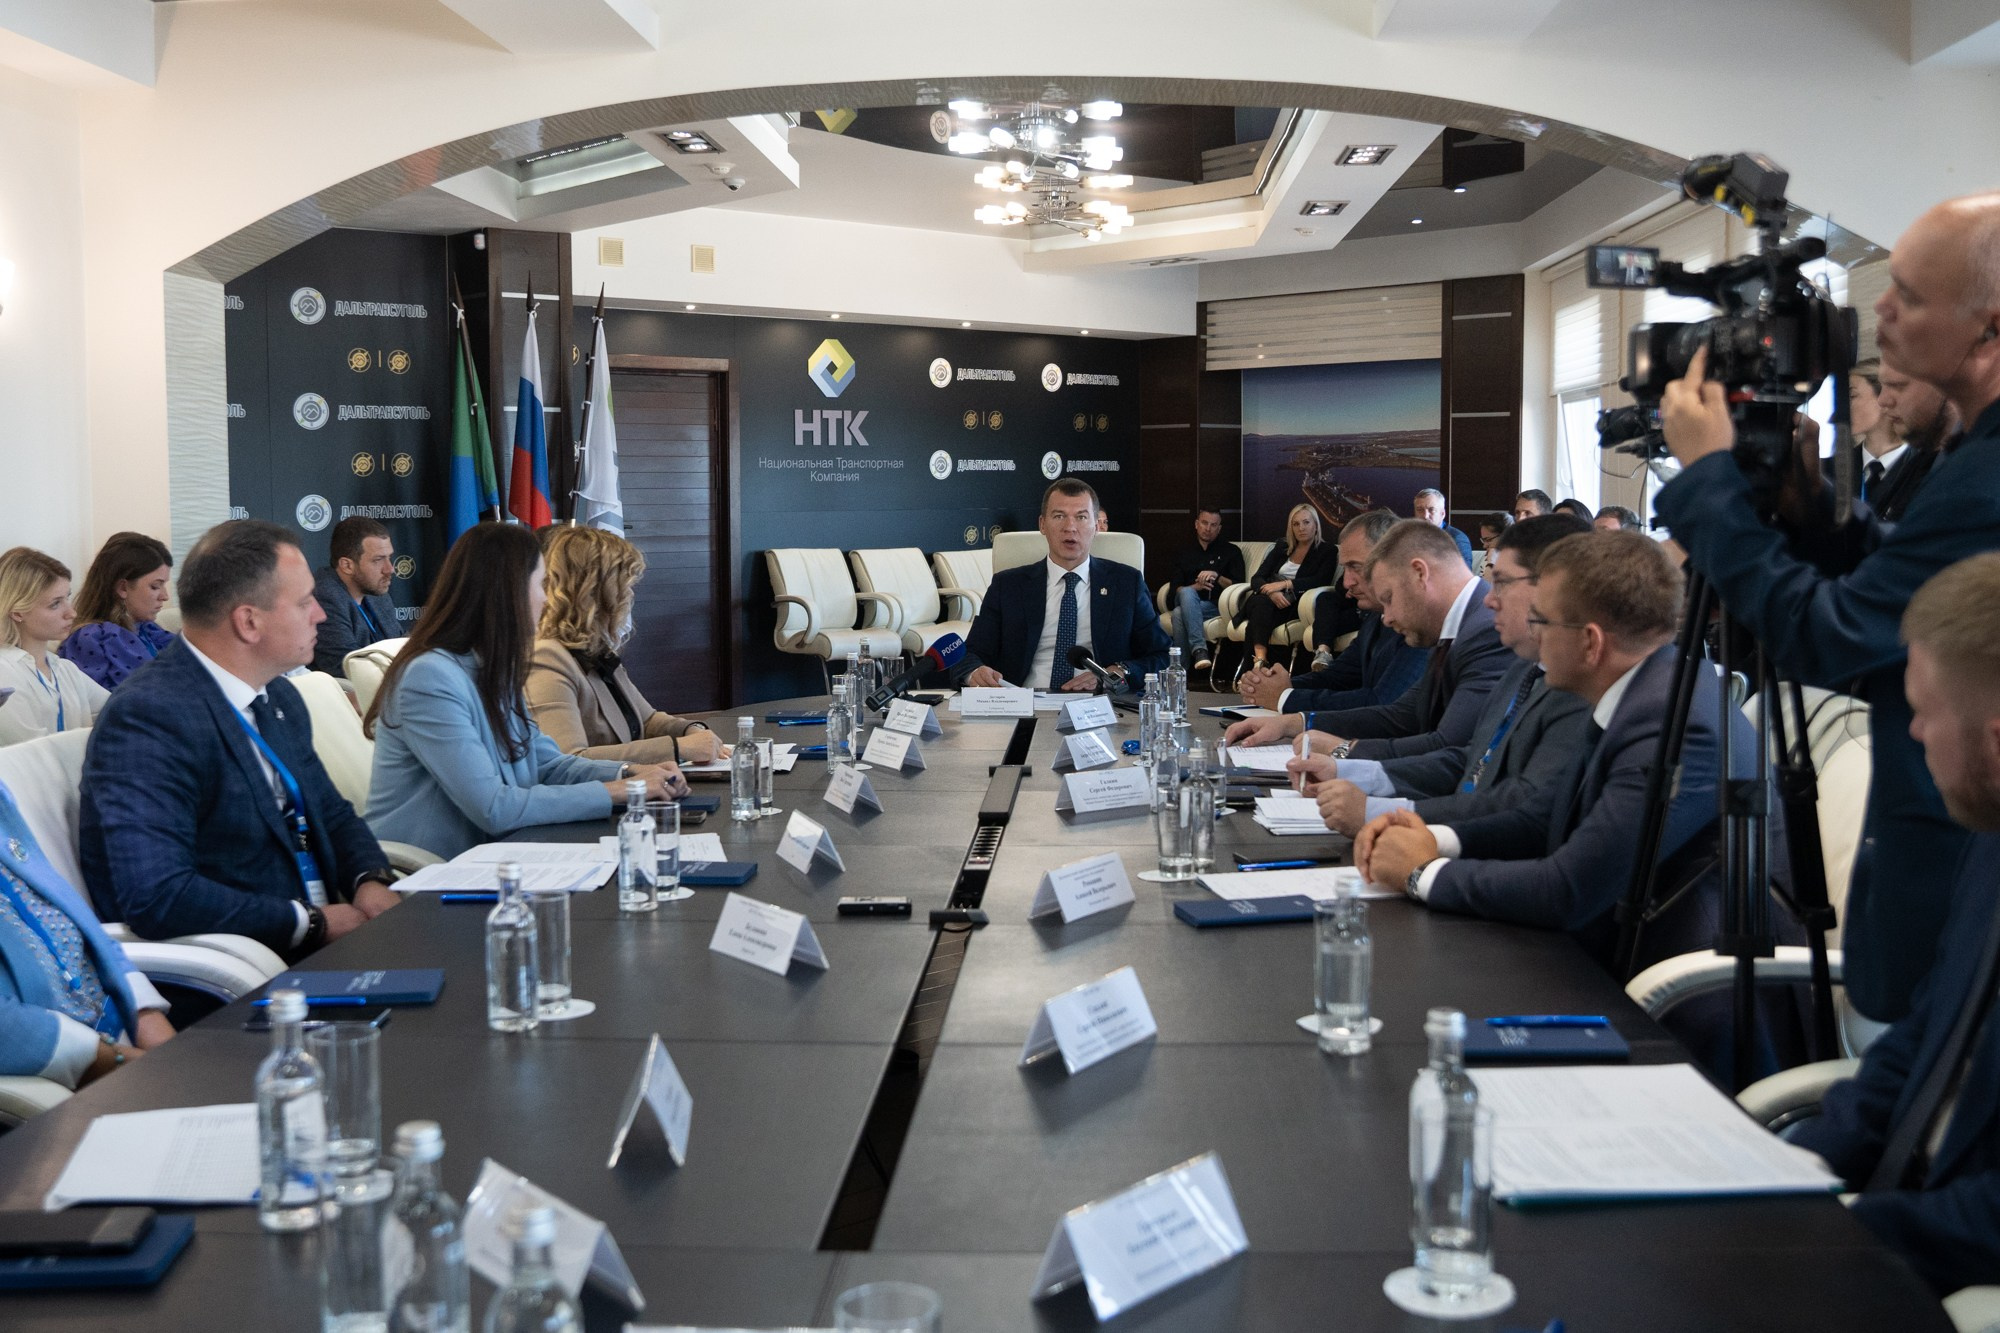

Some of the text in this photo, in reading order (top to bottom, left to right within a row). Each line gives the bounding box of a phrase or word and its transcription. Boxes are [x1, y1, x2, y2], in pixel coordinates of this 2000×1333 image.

[334, 300, 428, 319] ДАЛЬТРАНСУГОЛЬ
[957, 368, 1016, 381] ДАЛЬТРАНСУГОЛЬ
[1066, 373, 1120, 386] ДАЛЬТРАНСУГОЛЬ
[338, 405, 431, 420] ДАЛЬТРАНСУГОЛЬ
[794, 409, 869, 446] НТК
[759, 457, 904, 471] Национальная Транспортная
[957, 460, 1016, 472] ДАЛЬТРАНСУГОЛЬ
[1066, 460, 1120, 472] ДАЛЬТРАНСУГОЛЬ
[810, 471, 860, 482] Компания
[340, 504, 433, 521] ДАЛЬТРАНСУГОЛЬ
[941, 638, 963, 657] РОССИЯ
